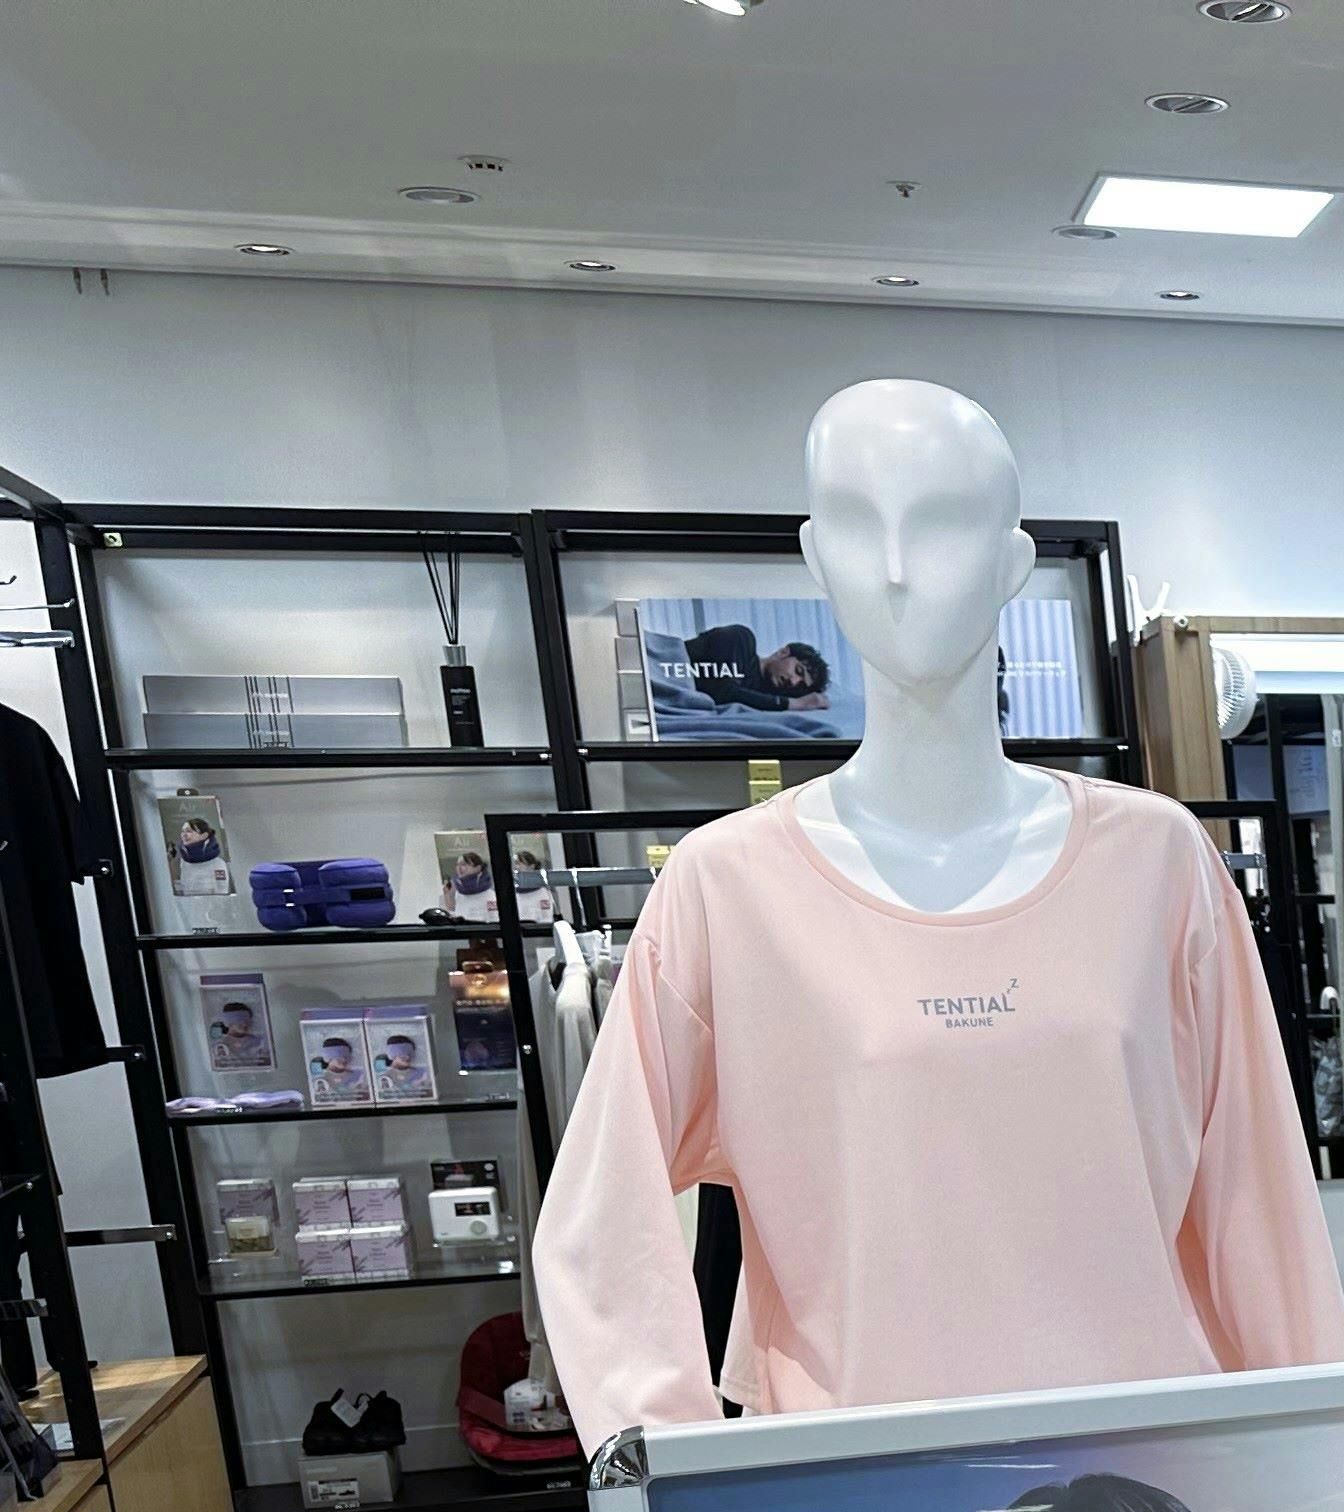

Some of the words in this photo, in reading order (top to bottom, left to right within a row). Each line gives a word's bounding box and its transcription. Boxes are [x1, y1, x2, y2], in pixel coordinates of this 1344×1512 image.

[660, 662, 745, 678] TENTIAL
[917, 993, 1016, 1015] TENTIAL
[945, 1017, 994, 1028] BAKUNE
